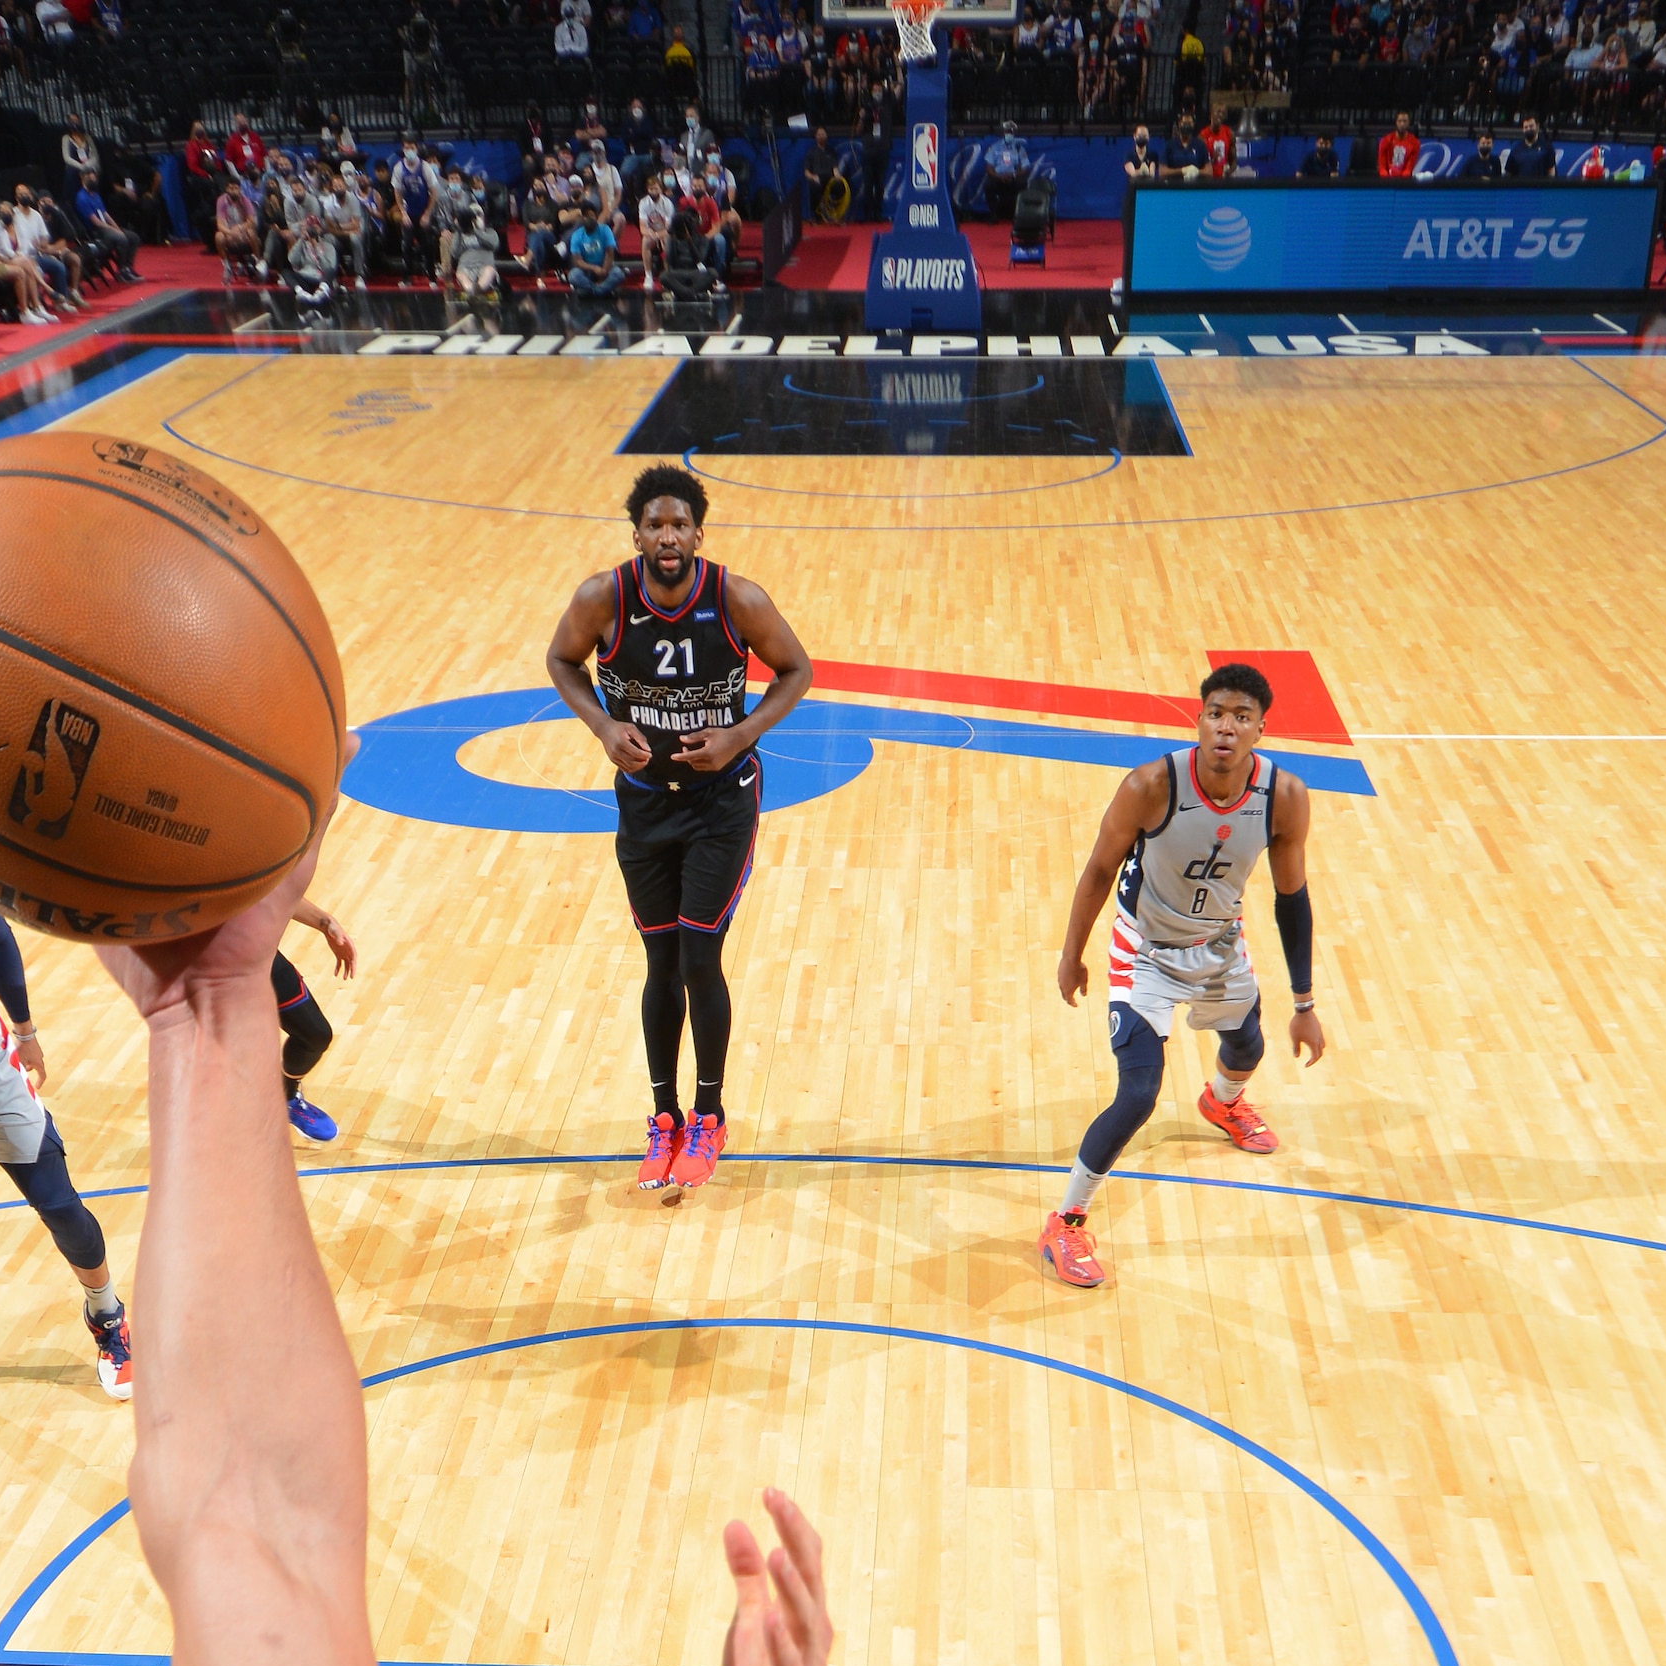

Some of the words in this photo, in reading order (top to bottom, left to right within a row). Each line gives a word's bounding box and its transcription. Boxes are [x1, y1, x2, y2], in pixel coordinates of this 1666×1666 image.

[909, 204, 939, 228] @NBA
[1402, 218, 1514, 259] AT&T
[1514, 218, 1589, 259] 5G
[896, 258, 966, 290] PLAYOFFS
[1247, 334, 1491, 356] USA
[654, 637, 695, 677] 21
[61, 711, 97, 746] NBA
[629, 705, 734, 731] PHILADELPHIA
[93, 794, 125, 822] BALL
[145, 788, 179, 812] @NBA
[124, 803, 158, 834] GAME
[159, 818, 211, 847] OFFICIAL
[1191, 888, 1208, 914] 8
